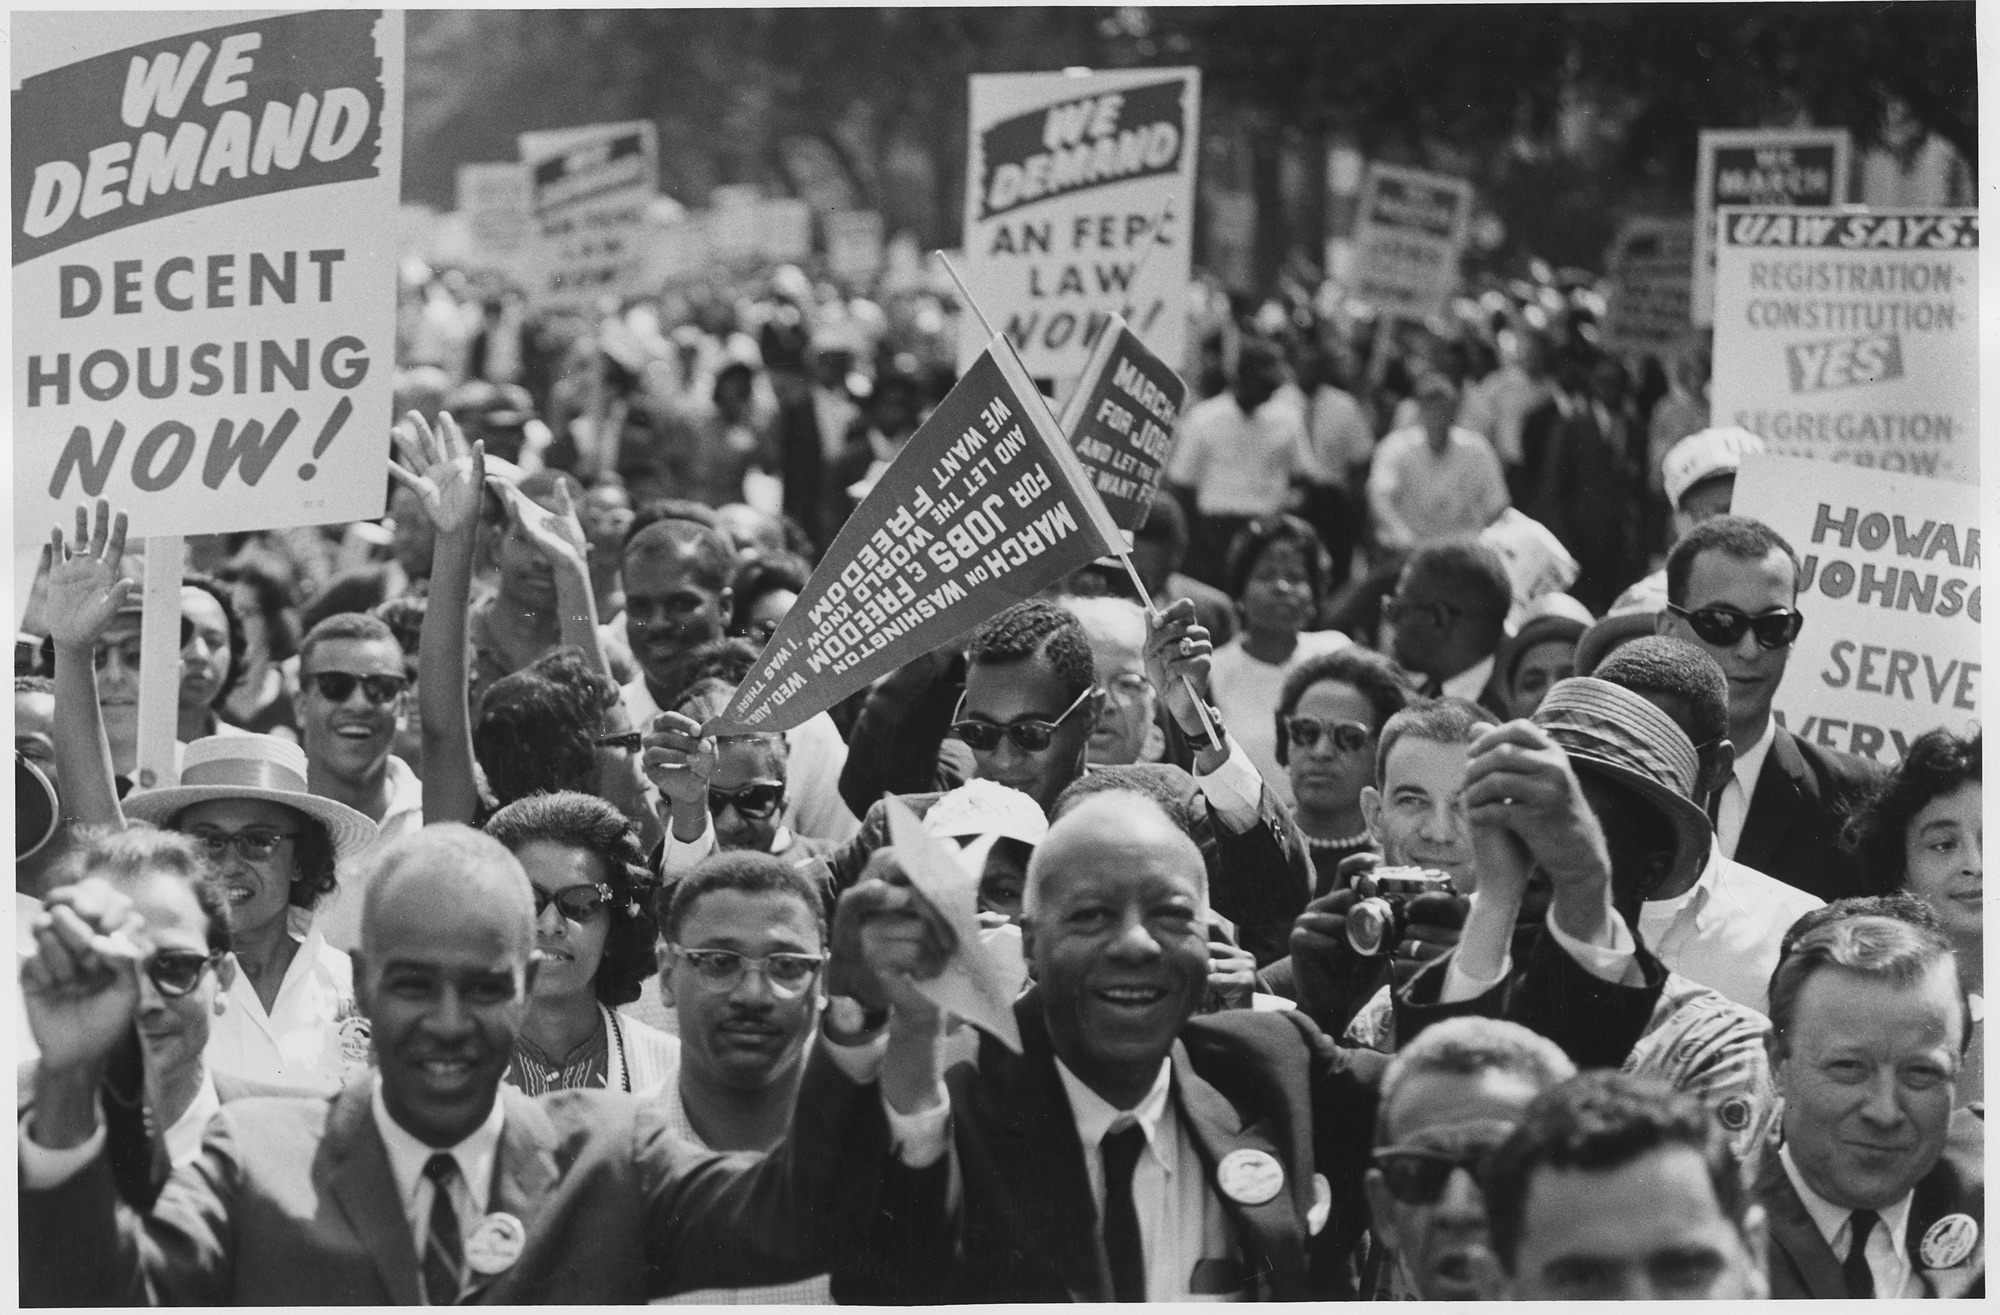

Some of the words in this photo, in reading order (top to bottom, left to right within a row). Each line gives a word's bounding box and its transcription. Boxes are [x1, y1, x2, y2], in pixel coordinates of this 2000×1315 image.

[121, 31, 262, 128] WE
[1042, 94, 1127, 149] WE
[23, 87, 371, 238] DEMAND
[988, 121, 1178, 210] DEMAND
[990, 222, 1052, 254] AN
[1733, 216, 1836, 246] UAW
[60, 249, 346, 319] DECENT
[1031, 263, 1136, 297] LAW
[27, 335, 371, 407] HOUSING
[1794, 338, 1890, 389] YES
[980, 396, 1012, 434] WE
[1096, 398, 1134, 435] FOR
[48, 396, 353, 499] NOW!
[932, 427, 988, 490] WANT
[994, 423, 1027, 464] AND
[1076, 436, 1113, 463] AND
[1112, 450, 1139, 474] LET
[962, 457, 997, 497] LET
[1008, 463, 1052, 508] FOR
[1097, 470, 1139, 500] WANT
[928, 494, 1007, 573] JOBS
[930, 492, 965, 526] THE
[808, 485, 934, 626] FREEDOM
[853, 525, 935, 602] WORLD
[982, 501, 1078, 578] MARCH
[964, 565, 989, 587] ON
[806, 575, 917, 674] FREEDOM
[808, 601, 853, 650] KNOW
[832, 579, 968, 675] WASHINGTON
[763, 647, 792, 680] WAS
[1820, 640, 1981, 710] SERVE
